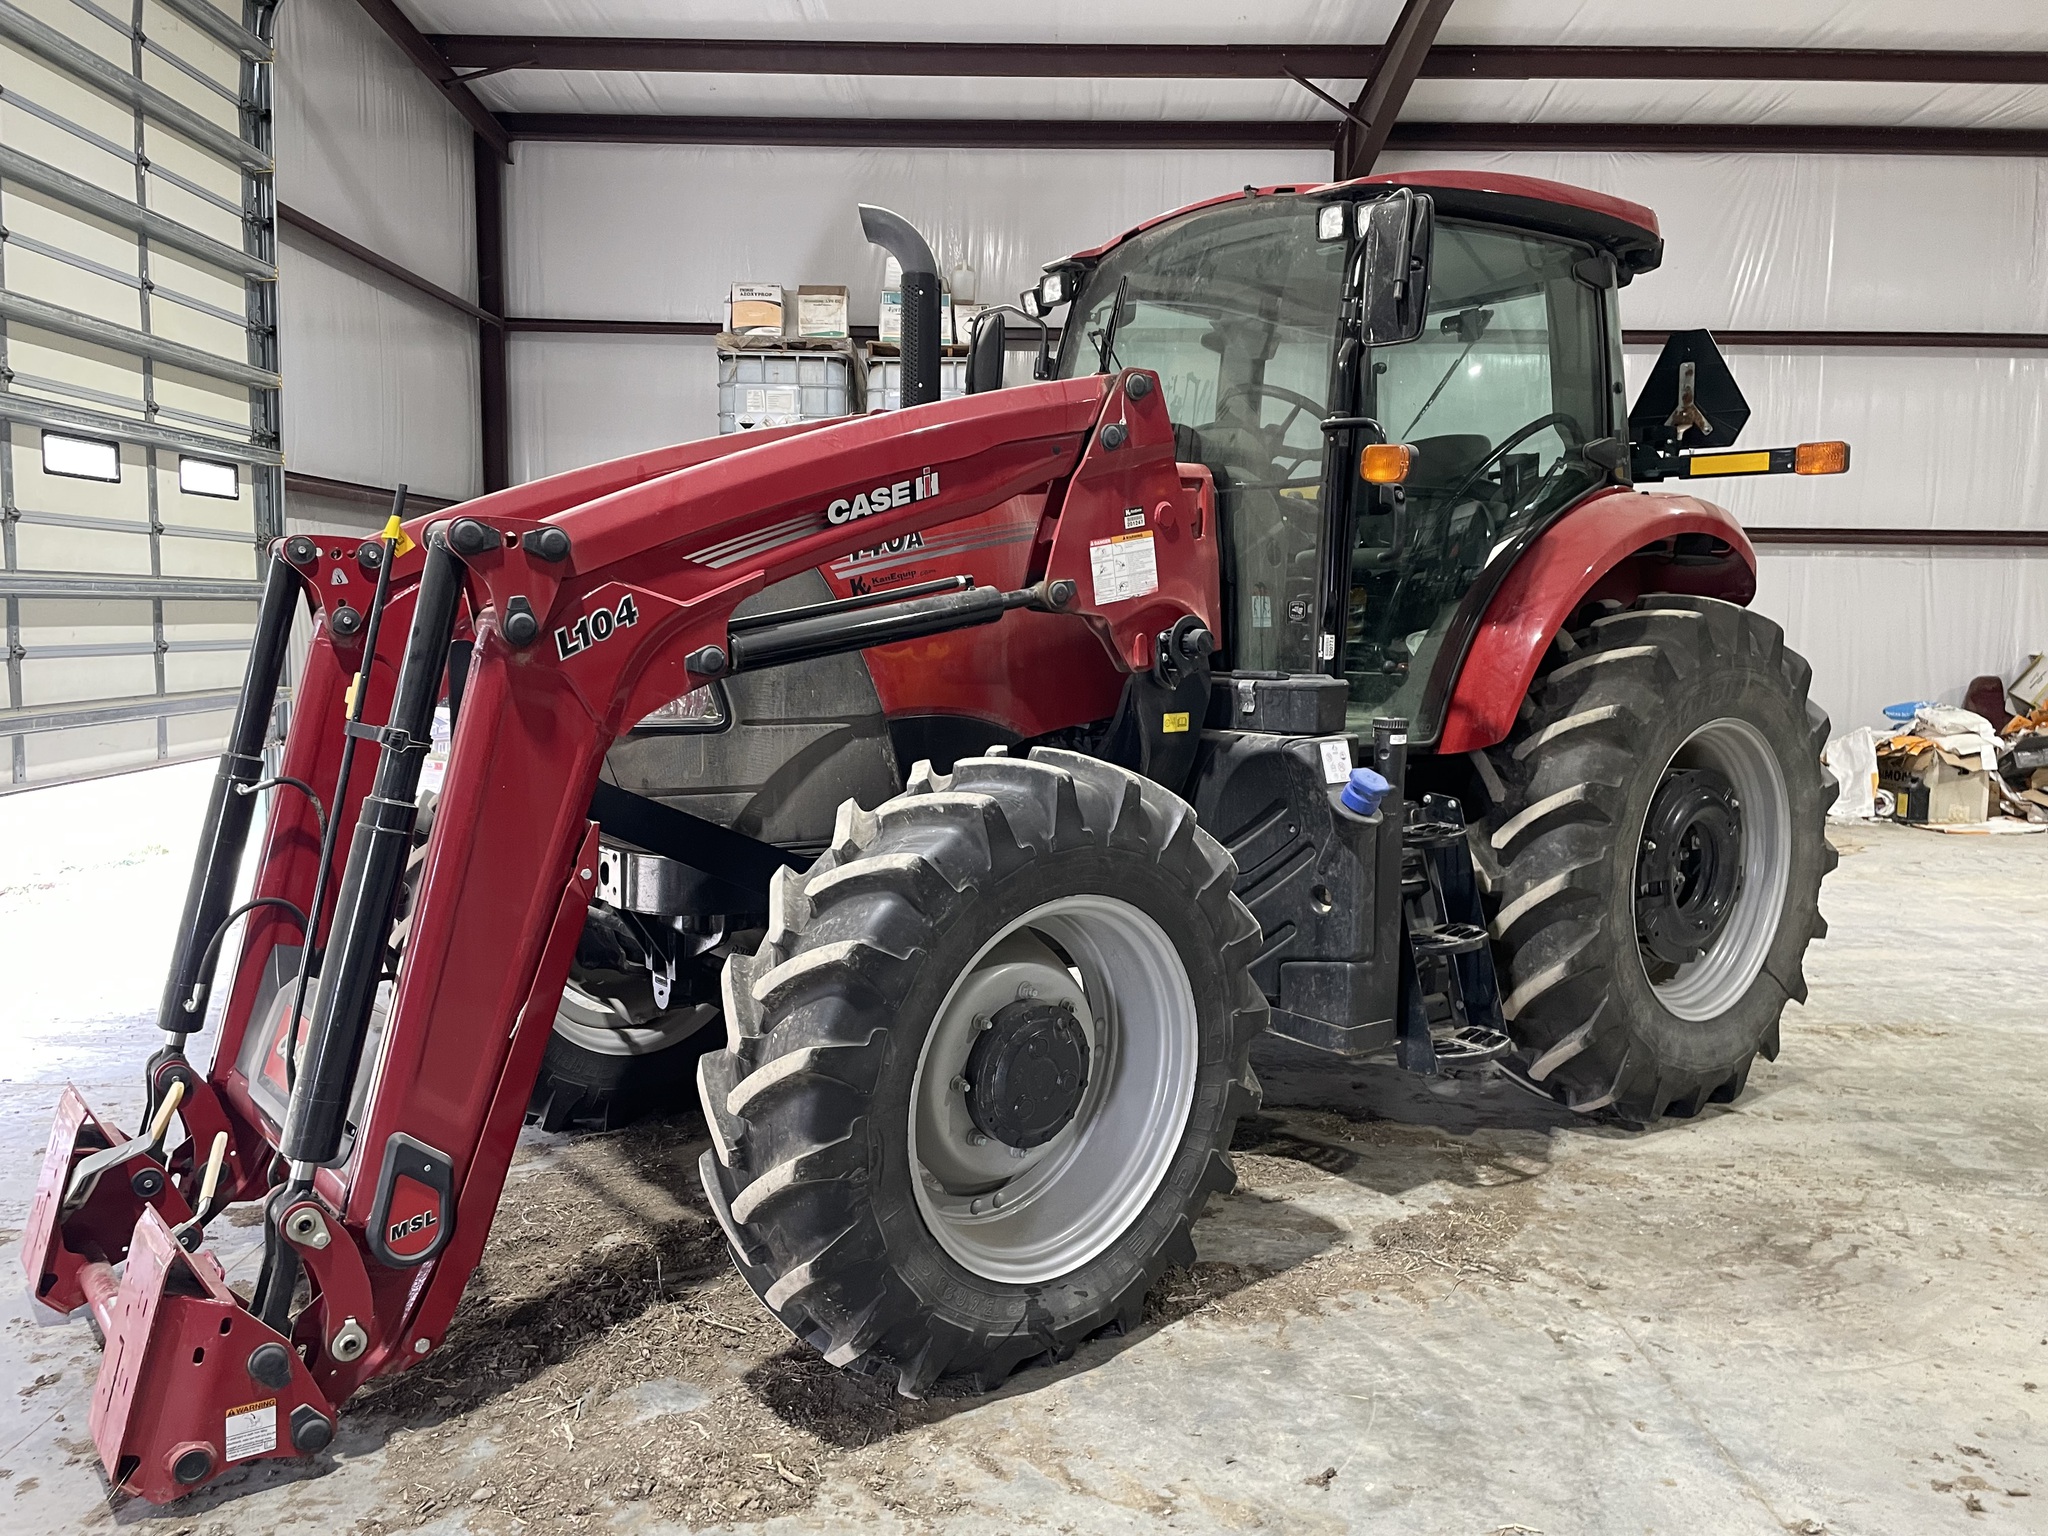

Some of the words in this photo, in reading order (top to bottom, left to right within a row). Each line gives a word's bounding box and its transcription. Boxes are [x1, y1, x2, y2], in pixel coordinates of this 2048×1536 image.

[827, 479, 911, 525] CASE
[871, 570, 917, 585] KanEquip
[553, 592, 640, 662] L104
[390, 1209, 438, 1243] MSL
[235, 1399, 276, 1415] WARNING
